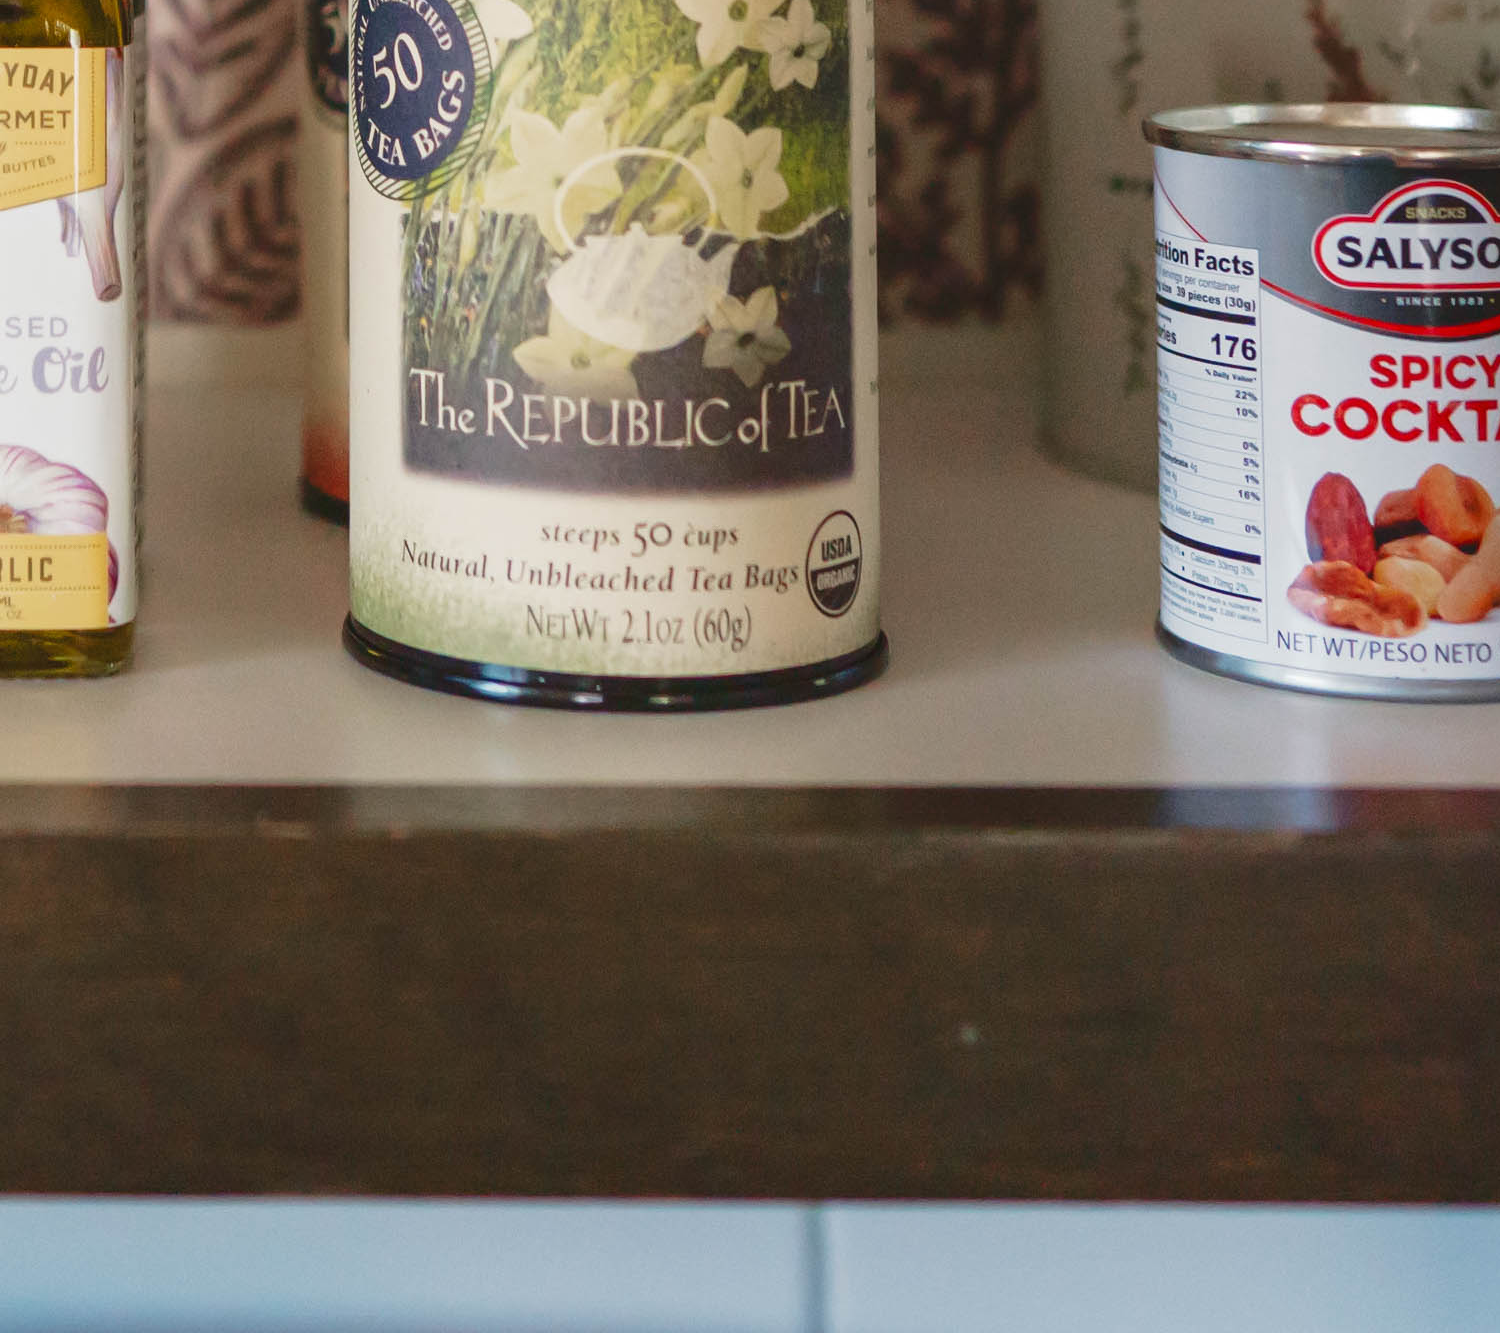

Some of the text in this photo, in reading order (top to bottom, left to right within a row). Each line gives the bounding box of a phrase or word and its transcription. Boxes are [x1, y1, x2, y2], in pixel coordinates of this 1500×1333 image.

[358, 14, 369, 113] NATURAL
[372, 32, 424, 110] 50
[367, 69, 466, 167] TEA BAGS
[1405, 205, 1468, 220] SNACKS
[1195, 248, 1254, 277] Facts
[1187, 290, 1221, 306] pieces
[1224, 296, 1257, 313] (30g)
[1396, 296, 1442, 308] SINCE
[1211, 333, 1257, 362] 176
[31, 345, 110, 394] Oil
[408, 368, 847, 454] The REPUBLIC of TEA
[1234, 389, 1259, 402] 22%
[540, 521, 740, 558] steeps 50 cups
[821, 538, 853, 561] USDA
[401, 539, 800, 594] Natural, Unbleached Tea Bags
[815, 570, 858, 594] ORGANIC
[693, 605, 753, 653] (60g)
[1277, 630, 1318, 654] NET
[1324, 636, 1428, 664] WT/PESO
[1434, 642, 1492, 664] NETO
